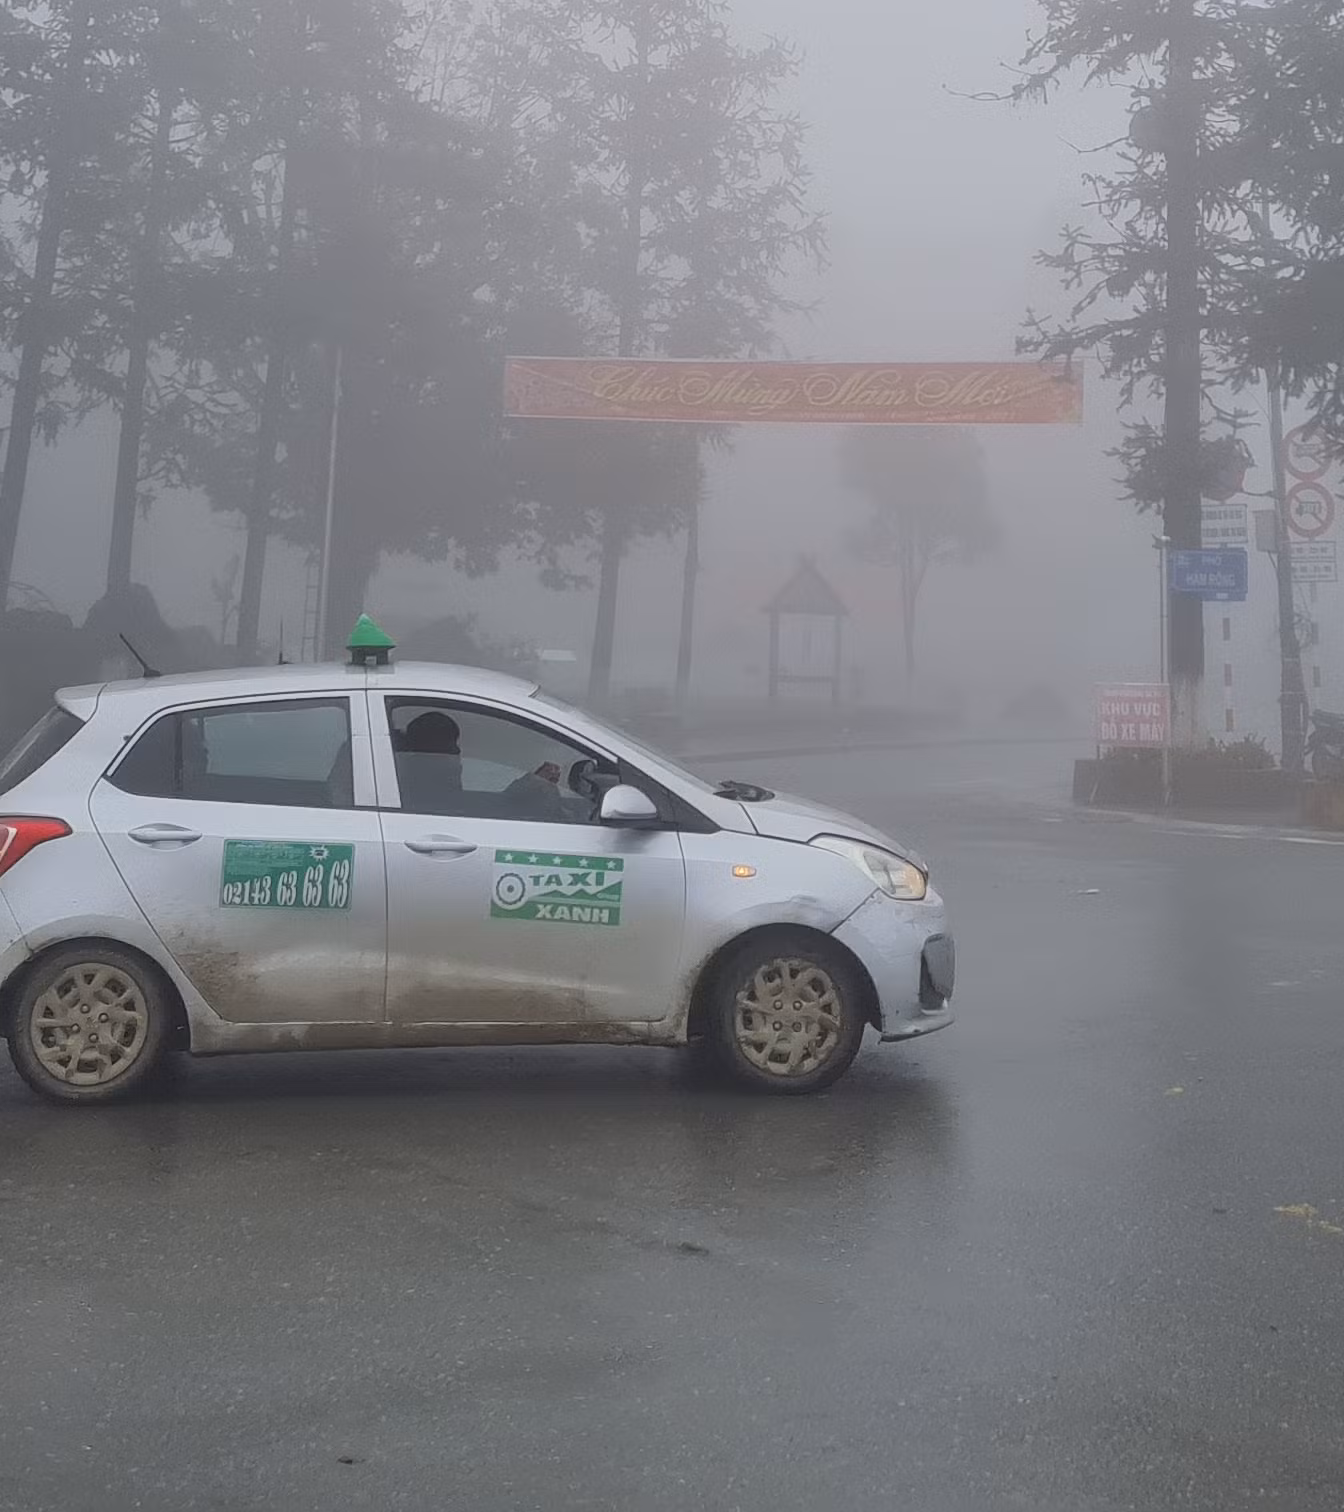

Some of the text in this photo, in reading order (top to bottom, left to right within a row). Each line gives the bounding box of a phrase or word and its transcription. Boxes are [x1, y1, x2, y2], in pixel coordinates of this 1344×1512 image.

[587, 364, 675, 404] Chúc
[803, 368, 911, 408] Năm
[1102, 701, 1130, 716] KHU
[1121, 723, 1136, 740] XE
[223, 875, 271, 905] 02143
[303, 863, 324, 907] 63
[328, 859, 350, 908] 63
[528, 871, 606, 887] TAXI
[535, 903, 610, 924] XANH
